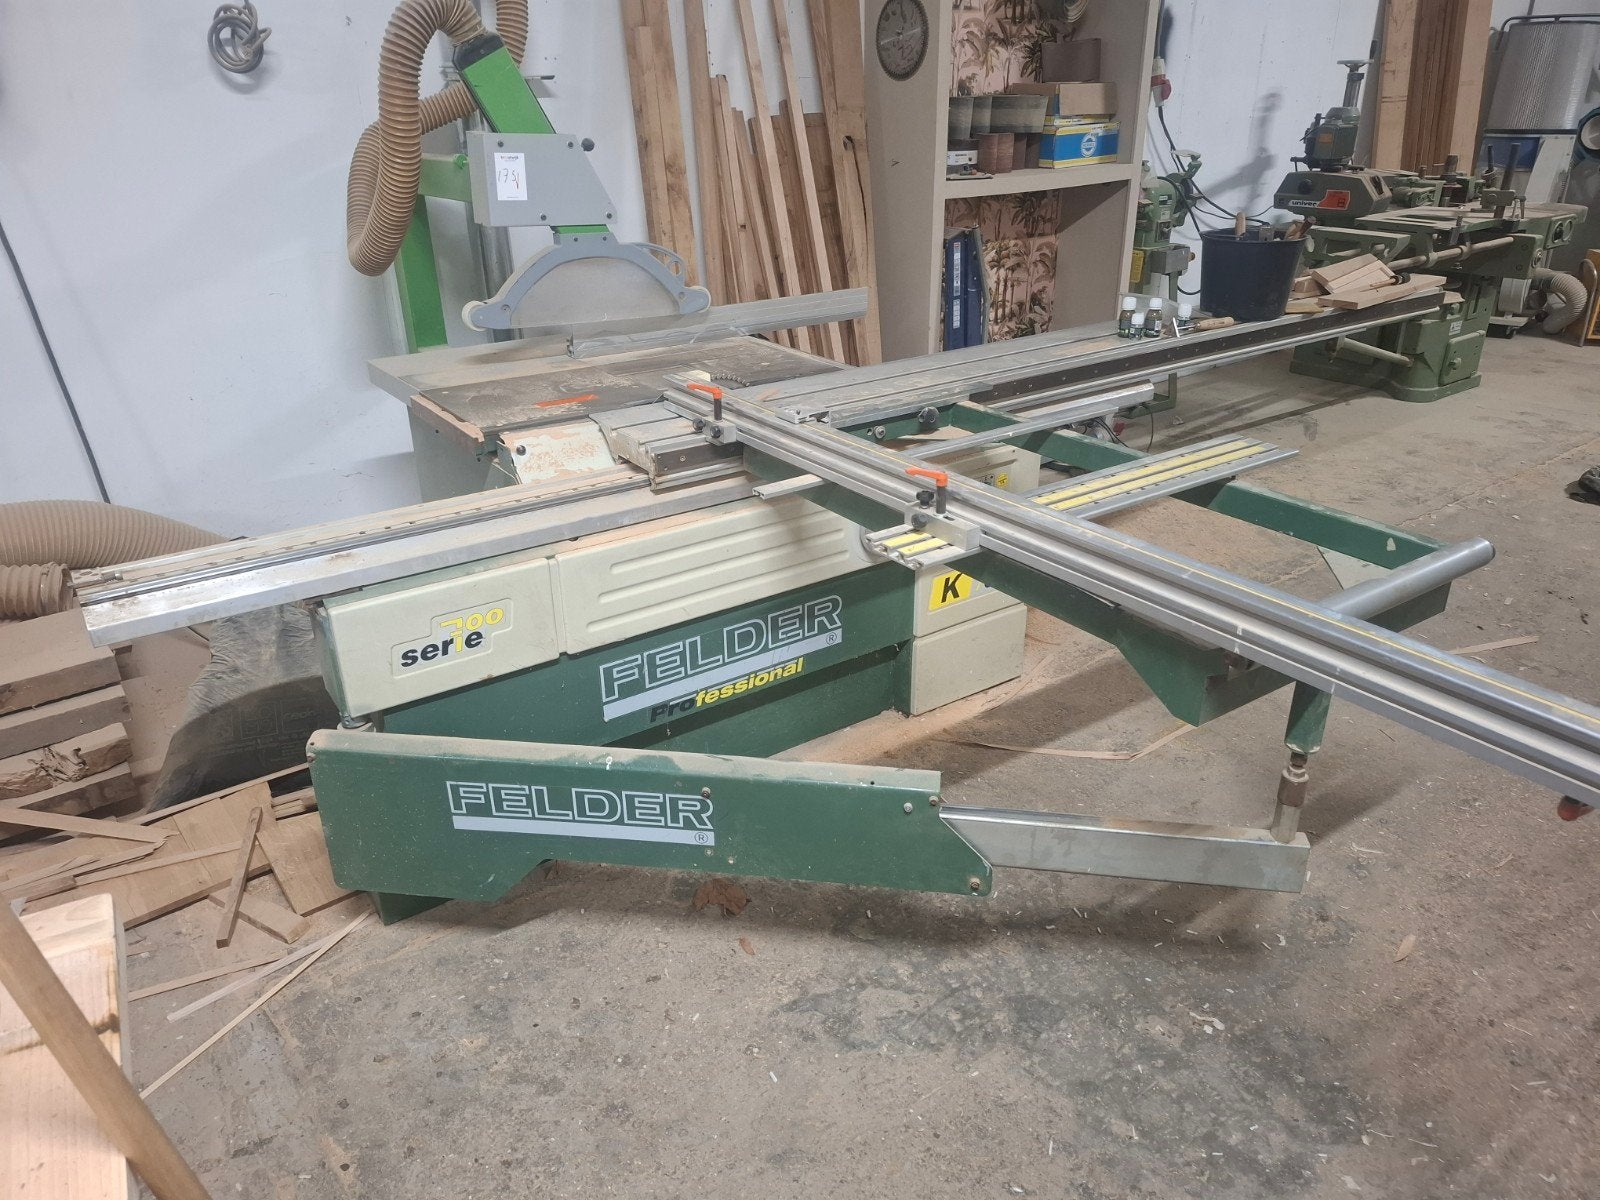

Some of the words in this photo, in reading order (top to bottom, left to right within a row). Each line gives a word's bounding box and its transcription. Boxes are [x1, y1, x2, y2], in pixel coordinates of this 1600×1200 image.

[941, 572, 963, 603] K
[400, 629, 483, 668] serie
[600, 595, 843, 702] FELDER
[650, 656, 805, 723] Professional
[446, 780, 714, 830] FELDER
